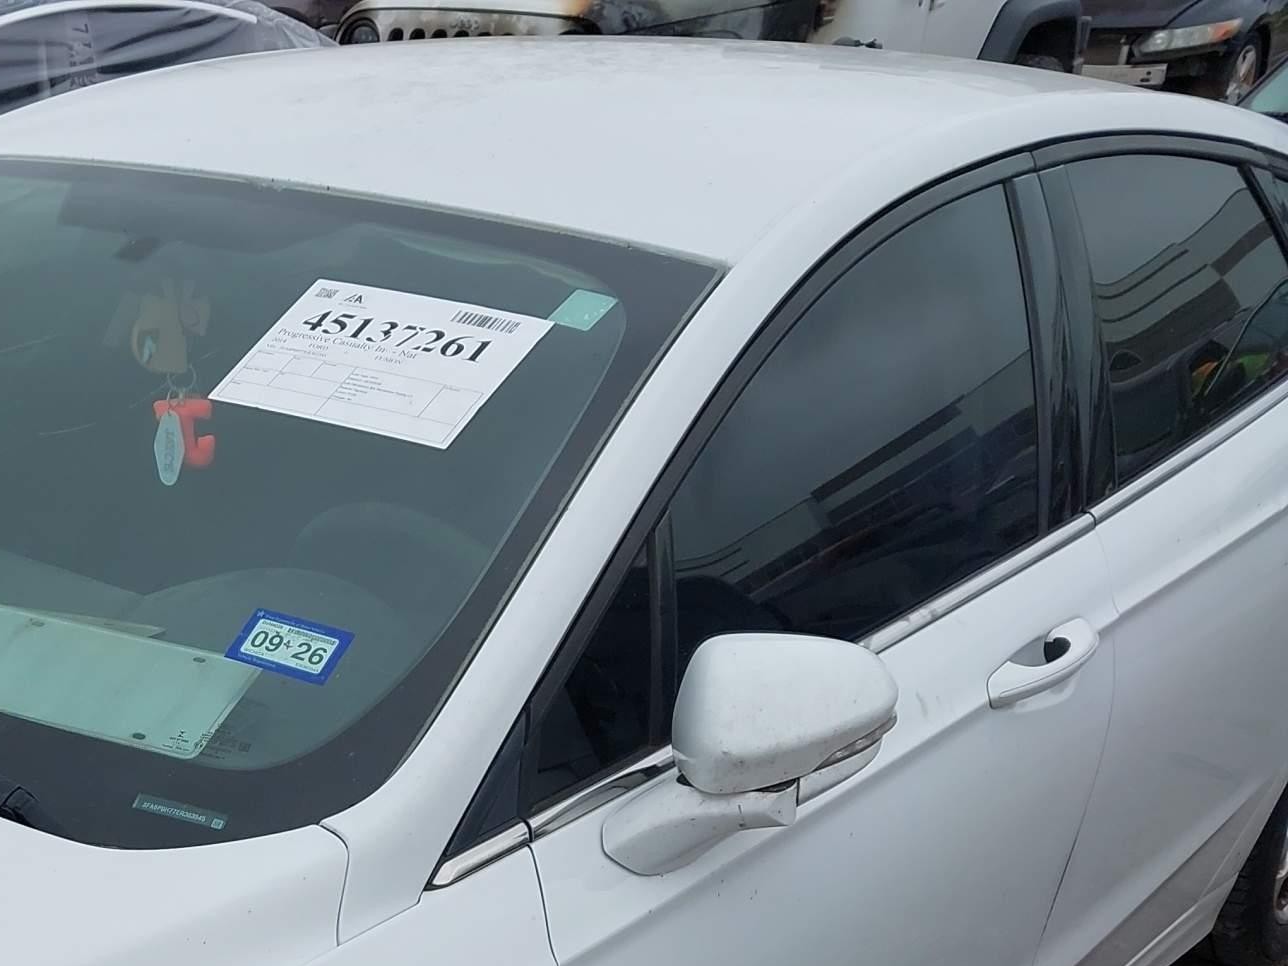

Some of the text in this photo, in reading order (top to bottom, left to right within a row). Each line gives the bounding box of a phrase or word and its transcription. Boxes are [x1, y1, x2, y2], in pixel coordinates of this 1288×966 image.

[278, 327, 331, 345] Progressive
[331, 337, 372, 353] Casualty
[302, 309, 495, 364] 45137261
[250, 630, 284, 652] 09
[291, 642, 328, 665] 26
